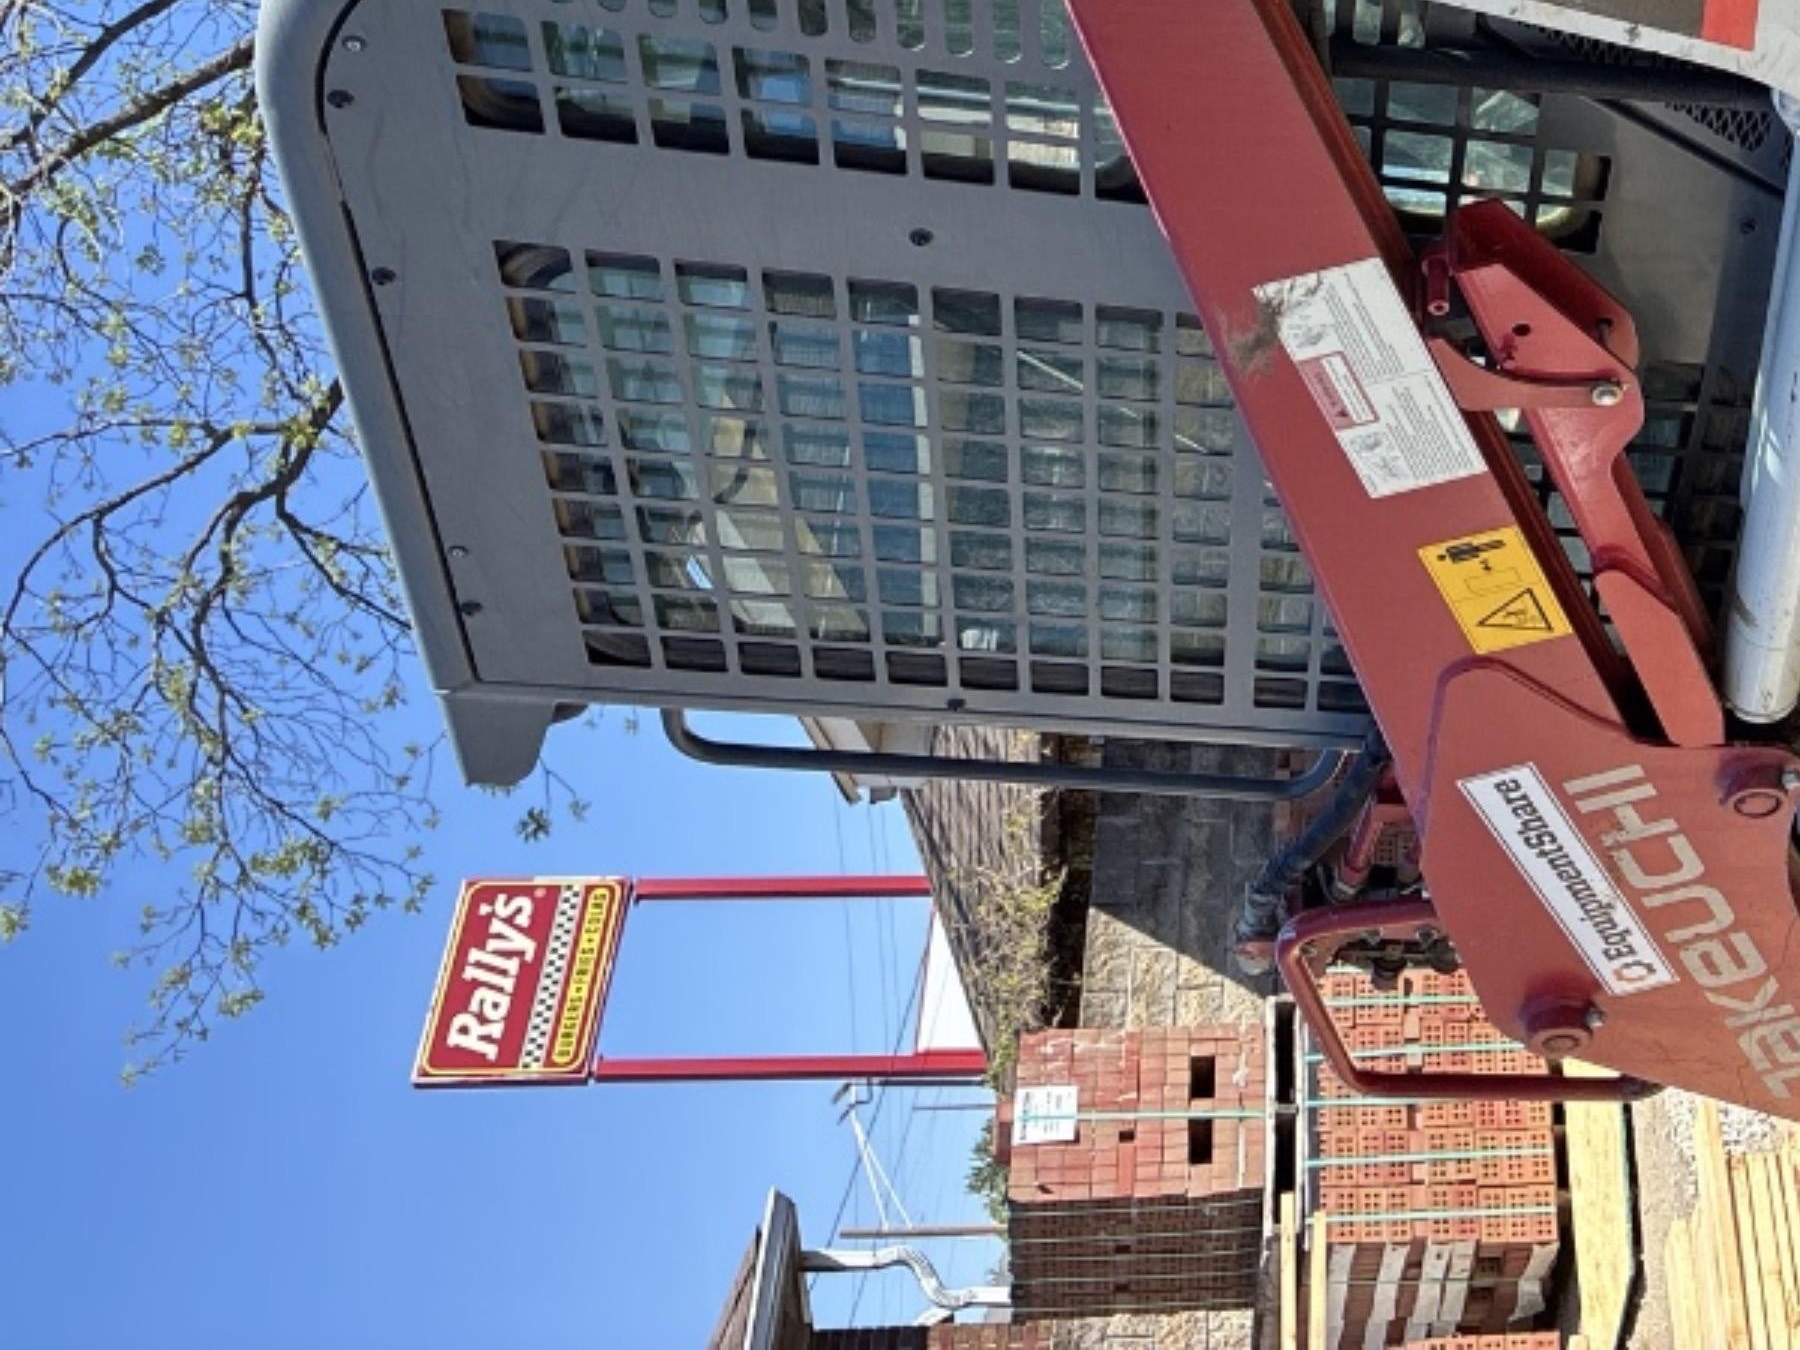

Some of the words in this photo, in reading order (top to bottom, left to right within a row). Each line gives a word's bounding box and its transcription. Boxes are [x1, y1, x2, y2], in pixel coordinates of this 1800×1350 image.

[1493, 777, 1633, 961] EquipmentShare
[446, 893, 537, 1062] Rally's
[557, 996, 583, 1058] BURGERS
